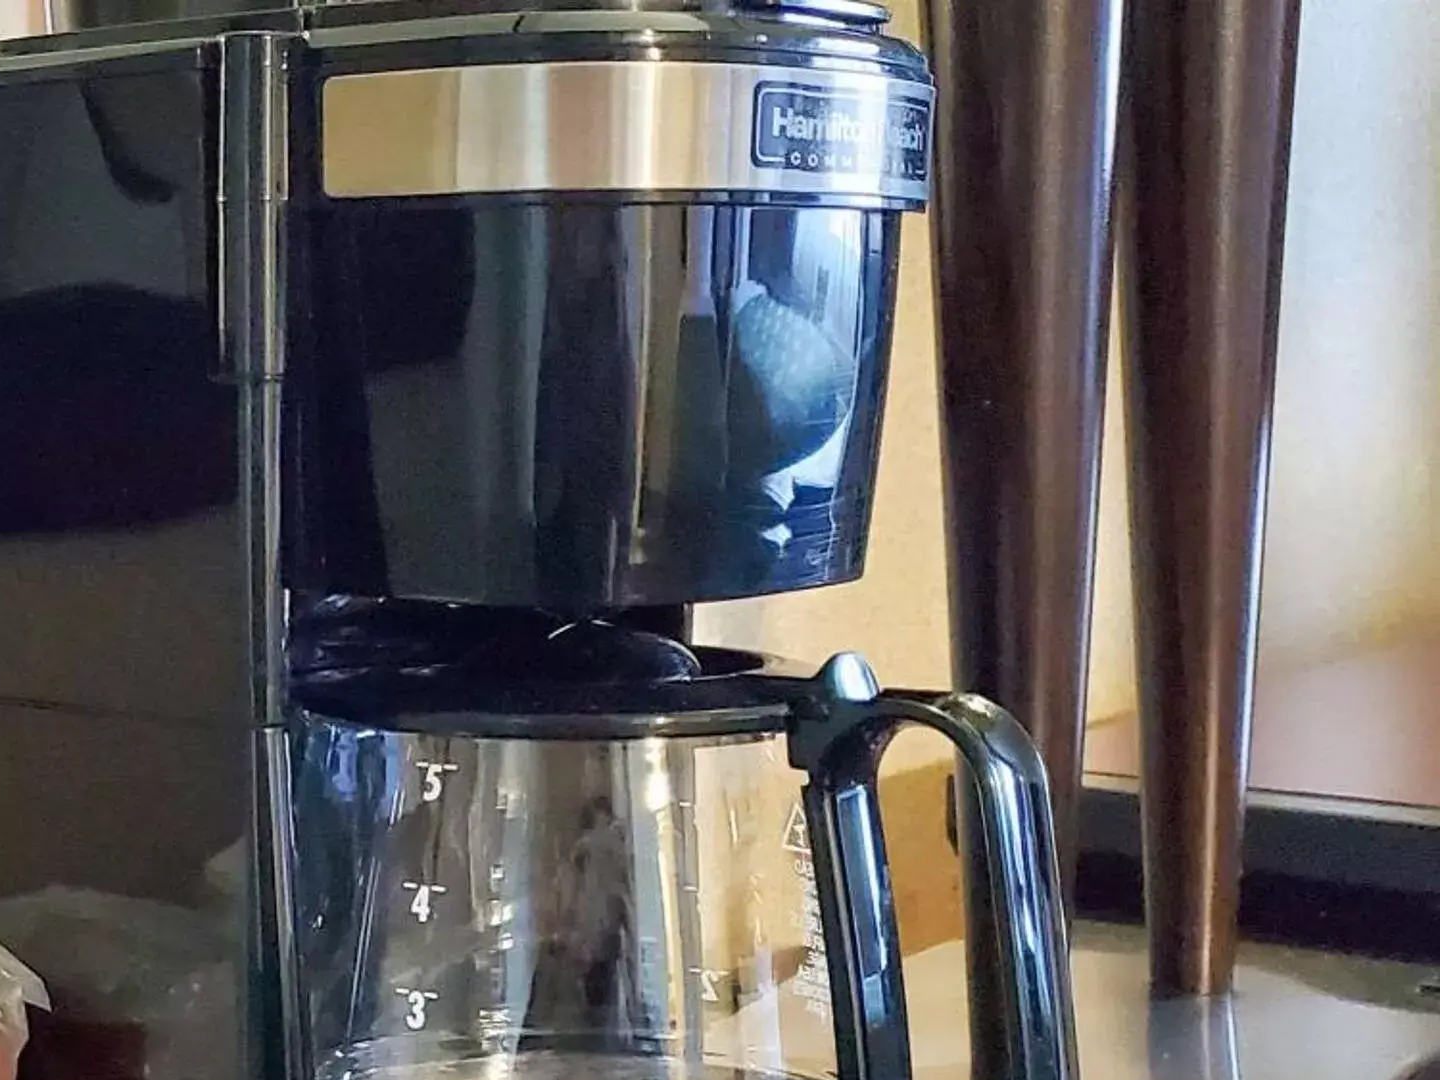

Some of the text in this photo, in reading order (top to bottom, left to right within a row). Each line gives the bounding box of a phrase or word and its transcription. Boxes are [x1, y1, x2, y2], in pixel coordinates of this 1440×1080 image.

[421, 765, 443, 801] 5
[410, 885, 431, 923] 4
[405, 991, 426, 1031] 3
